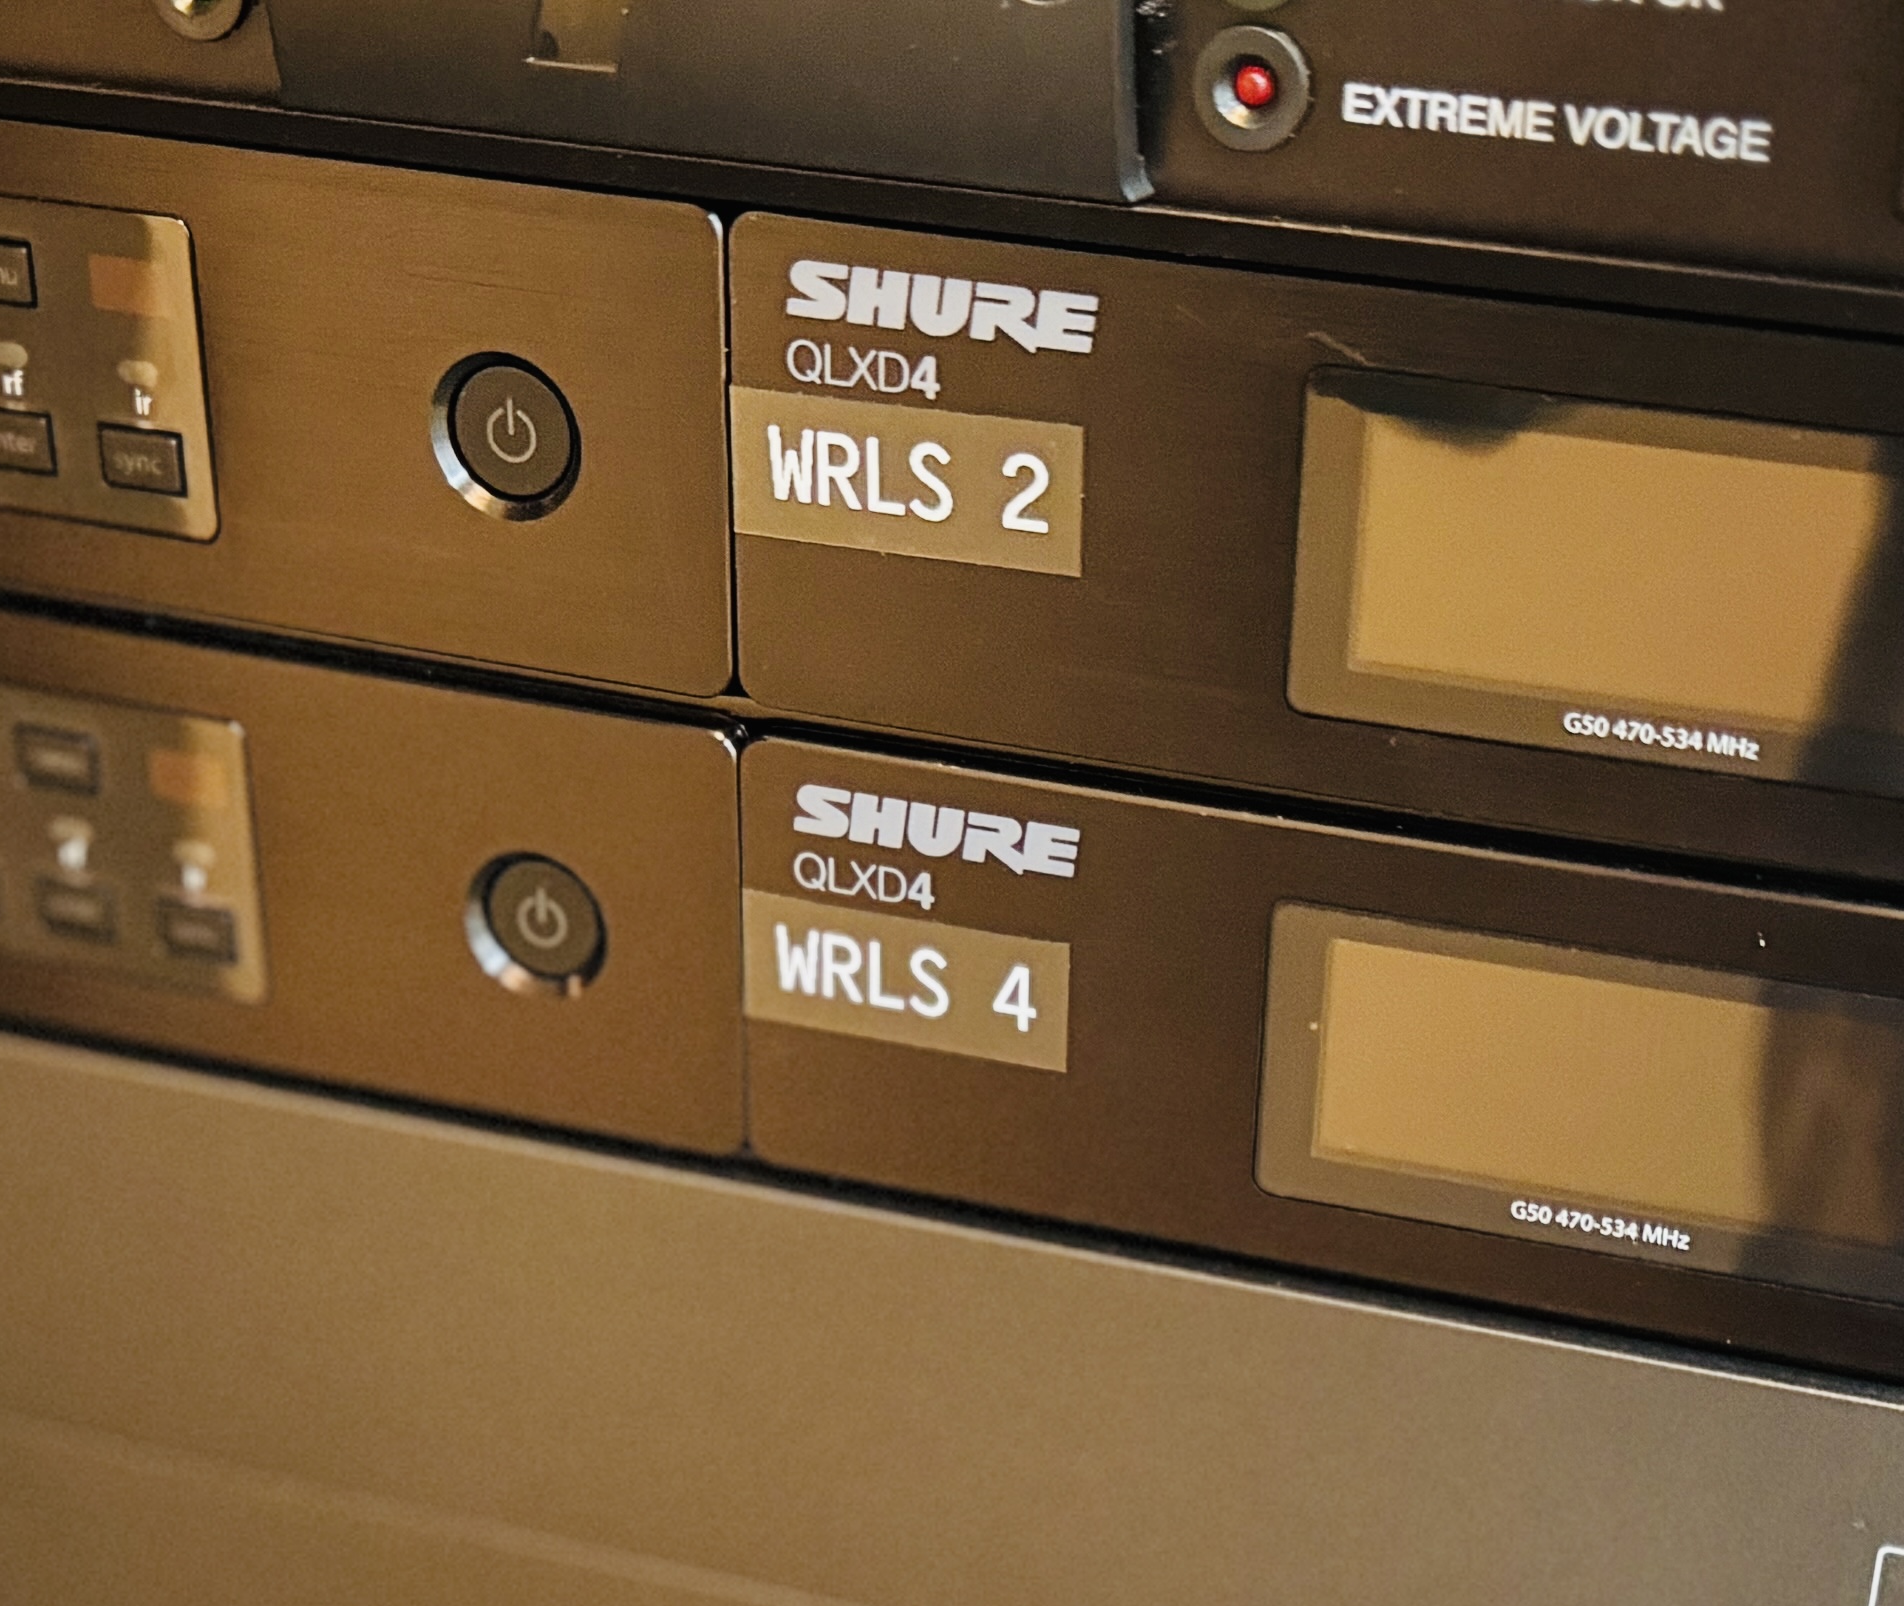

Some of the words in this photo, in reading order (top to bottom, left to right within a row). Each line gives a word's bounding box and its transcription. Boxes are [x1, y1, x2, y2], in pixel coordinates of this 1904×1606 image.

[1341, 82, 1558, 144] EXTREME
[1563, 103, 1774, 164] VOLTAGE
[786, 259, 1099, 355] SHURE
[1, 370, 25, 397] rf
[786, 339, 942, 400] QLXD4
[134, 388, 153, 416] ir
[766, 423, 953, 524] WRLS
[1000, 453, 1051, 535] 2
[1563, 711, 1609, 738] G50
[1612, 719, 1703, 752] 470-534
[1706, 731, 1760, 762] MHz
[792, 783, 1081, 878] SHURE
[792, 852, 936, 911] QLXD4
[774, 922, 950, 1019] WRLS
[992, 964, 1037, 1033] 4
[1510, 1200, 1552, 1225] G50
[1555, 1211, 1641, 1241] 470-534
[1642, 1223, 1691, 1252] MHz
